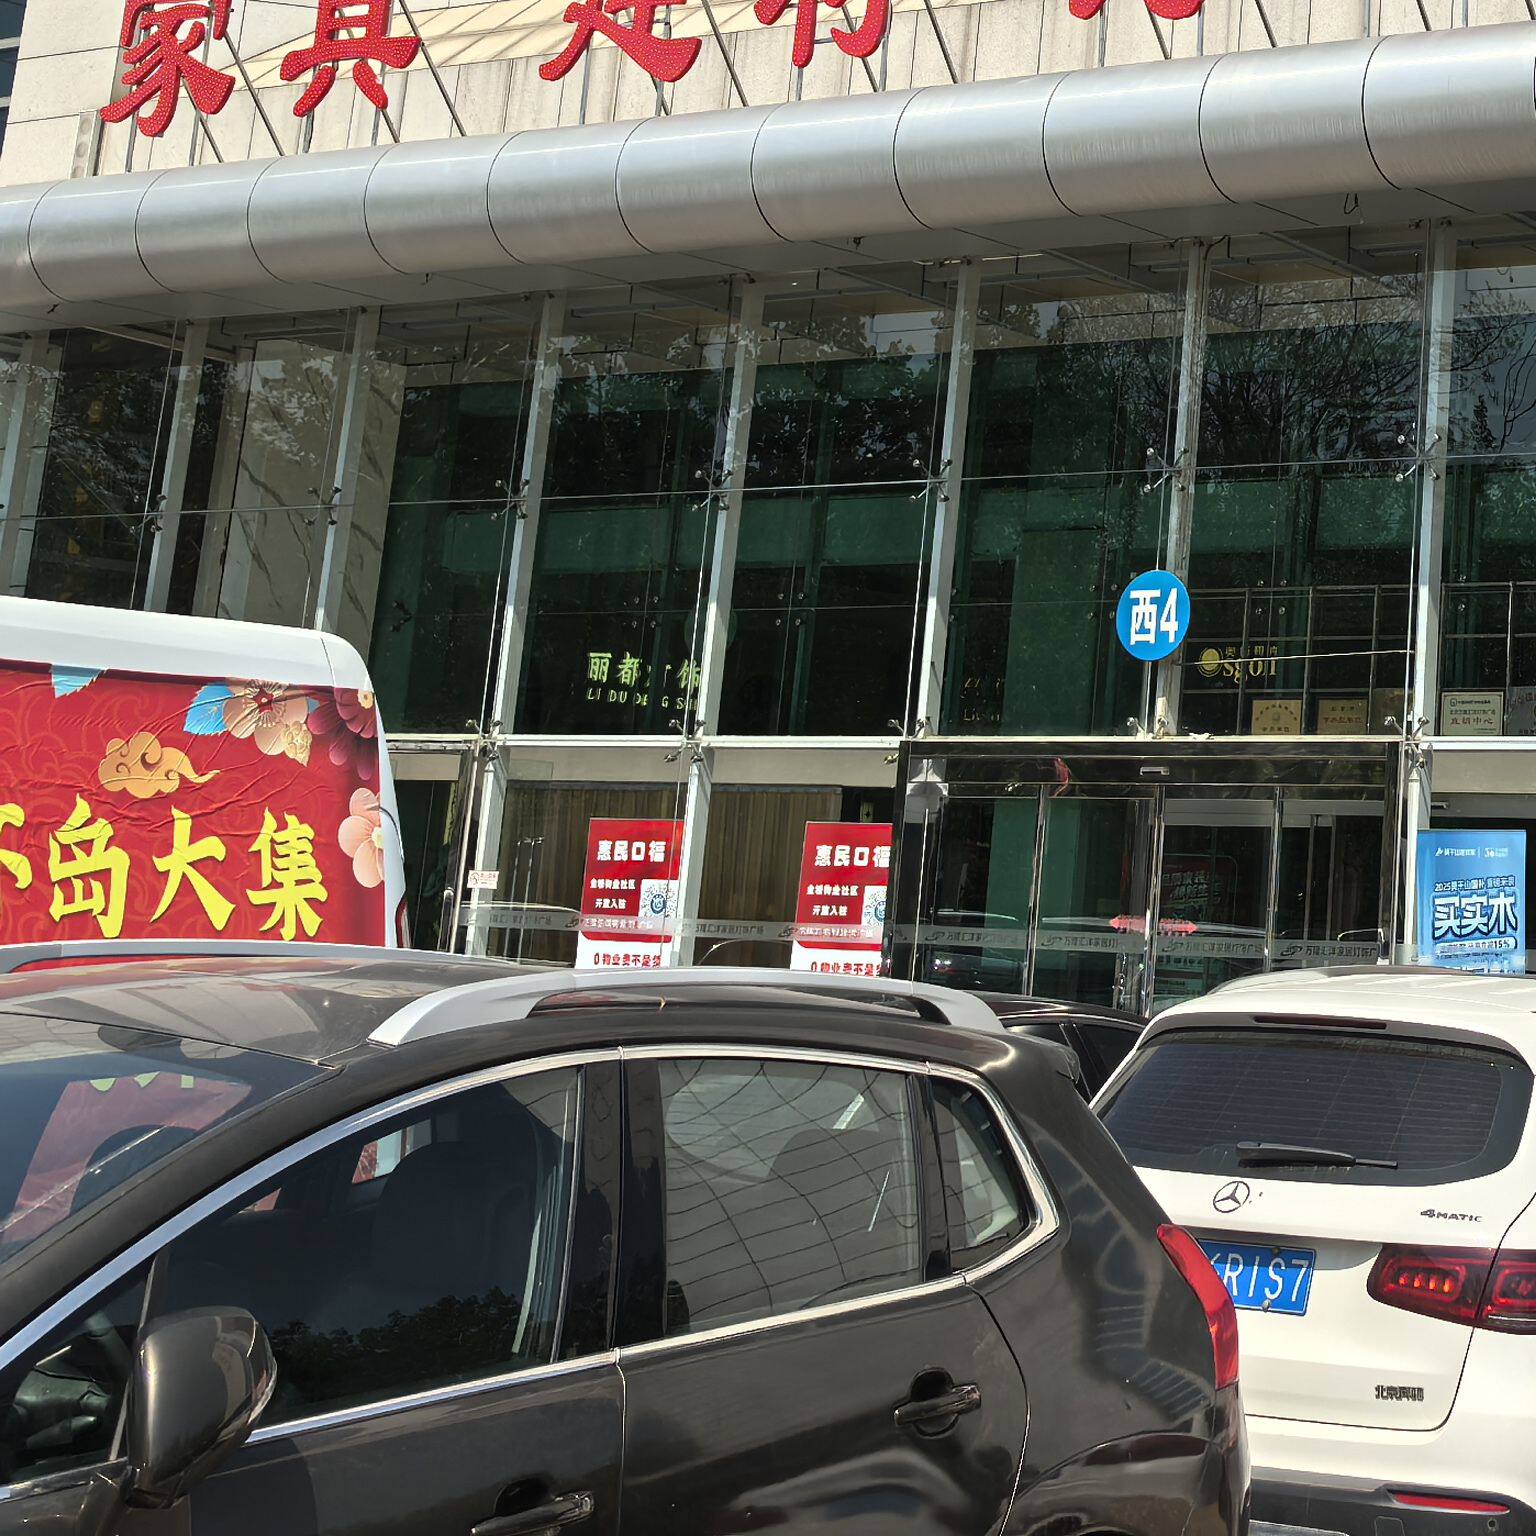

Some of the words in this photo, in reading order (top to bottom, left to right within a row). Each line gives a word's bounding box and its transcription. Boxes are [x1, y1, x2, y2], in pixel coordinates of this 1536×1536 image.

[1129, 588, 1180, 645] 西4
[587, 651, 701, 691] 丽都饰
[597, 840, 667, 862] 惠民口福
[1433, 891, 1518, 939] 买实木
[1420, 1209, 1483, 1222] 4MATIC
